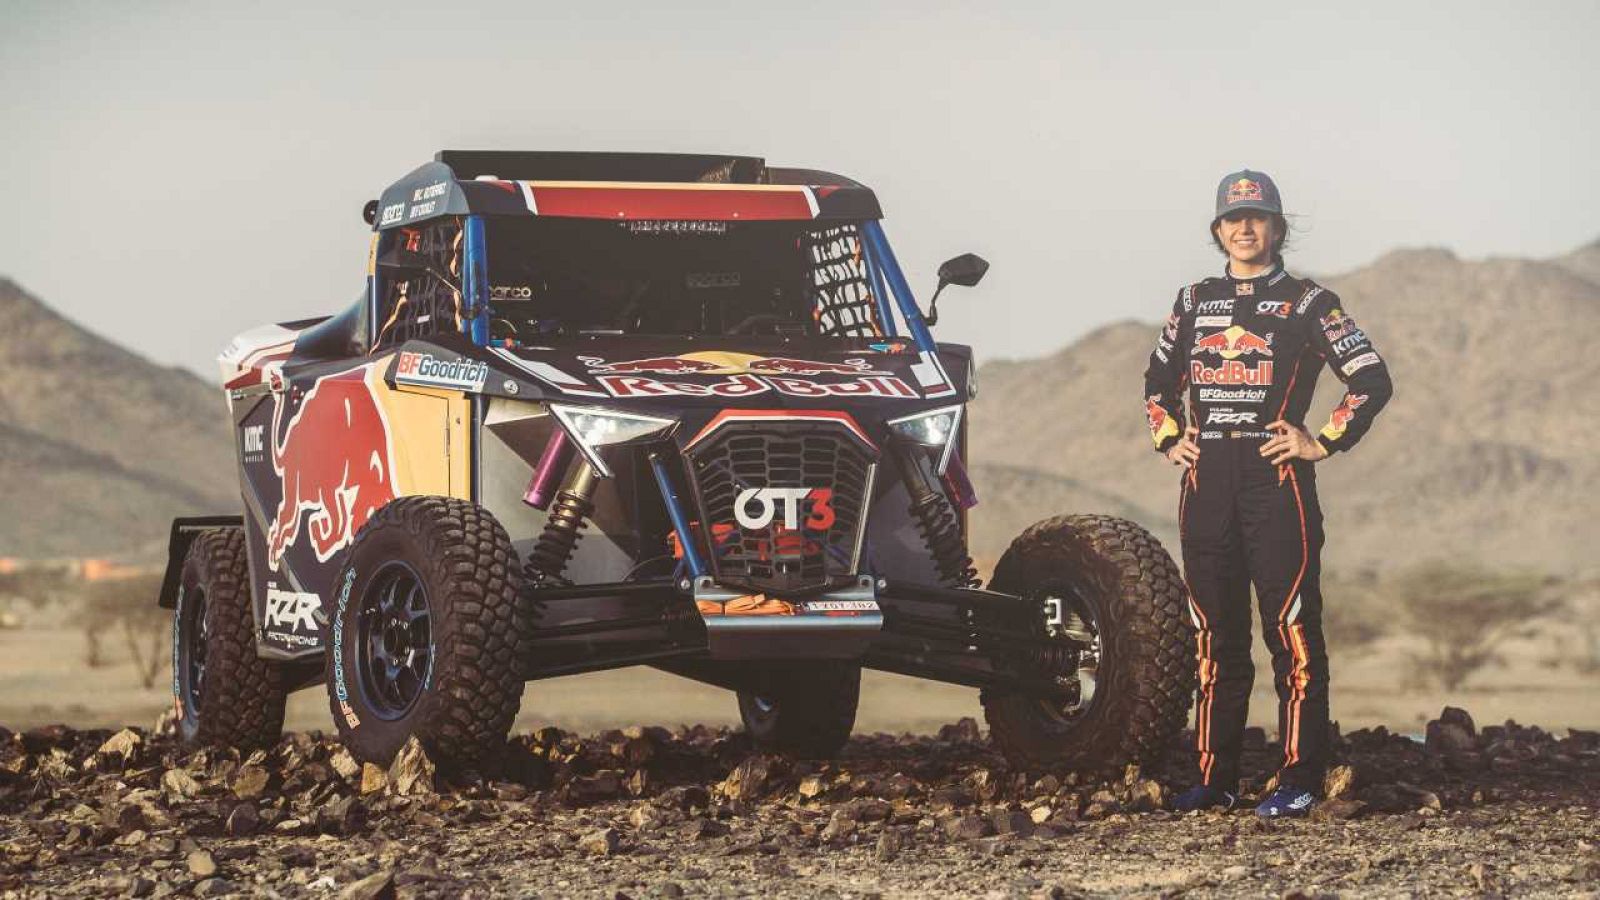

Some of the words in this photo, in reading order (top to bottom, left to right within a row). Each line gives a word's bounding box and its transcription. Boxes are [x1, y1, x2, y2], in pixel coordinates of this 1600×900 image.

[1257, 300, 1292, 315] OT3
[399, 354, 489, 382] BFGoodrich
[596, 374, 772, 398] Red
[764, 378, 920, 399] Bull
[1199, 389, 1266, 400] BFGoodrich
[734, 488, 836, 530] OT3
[264, 589, 322, 633] RZR
